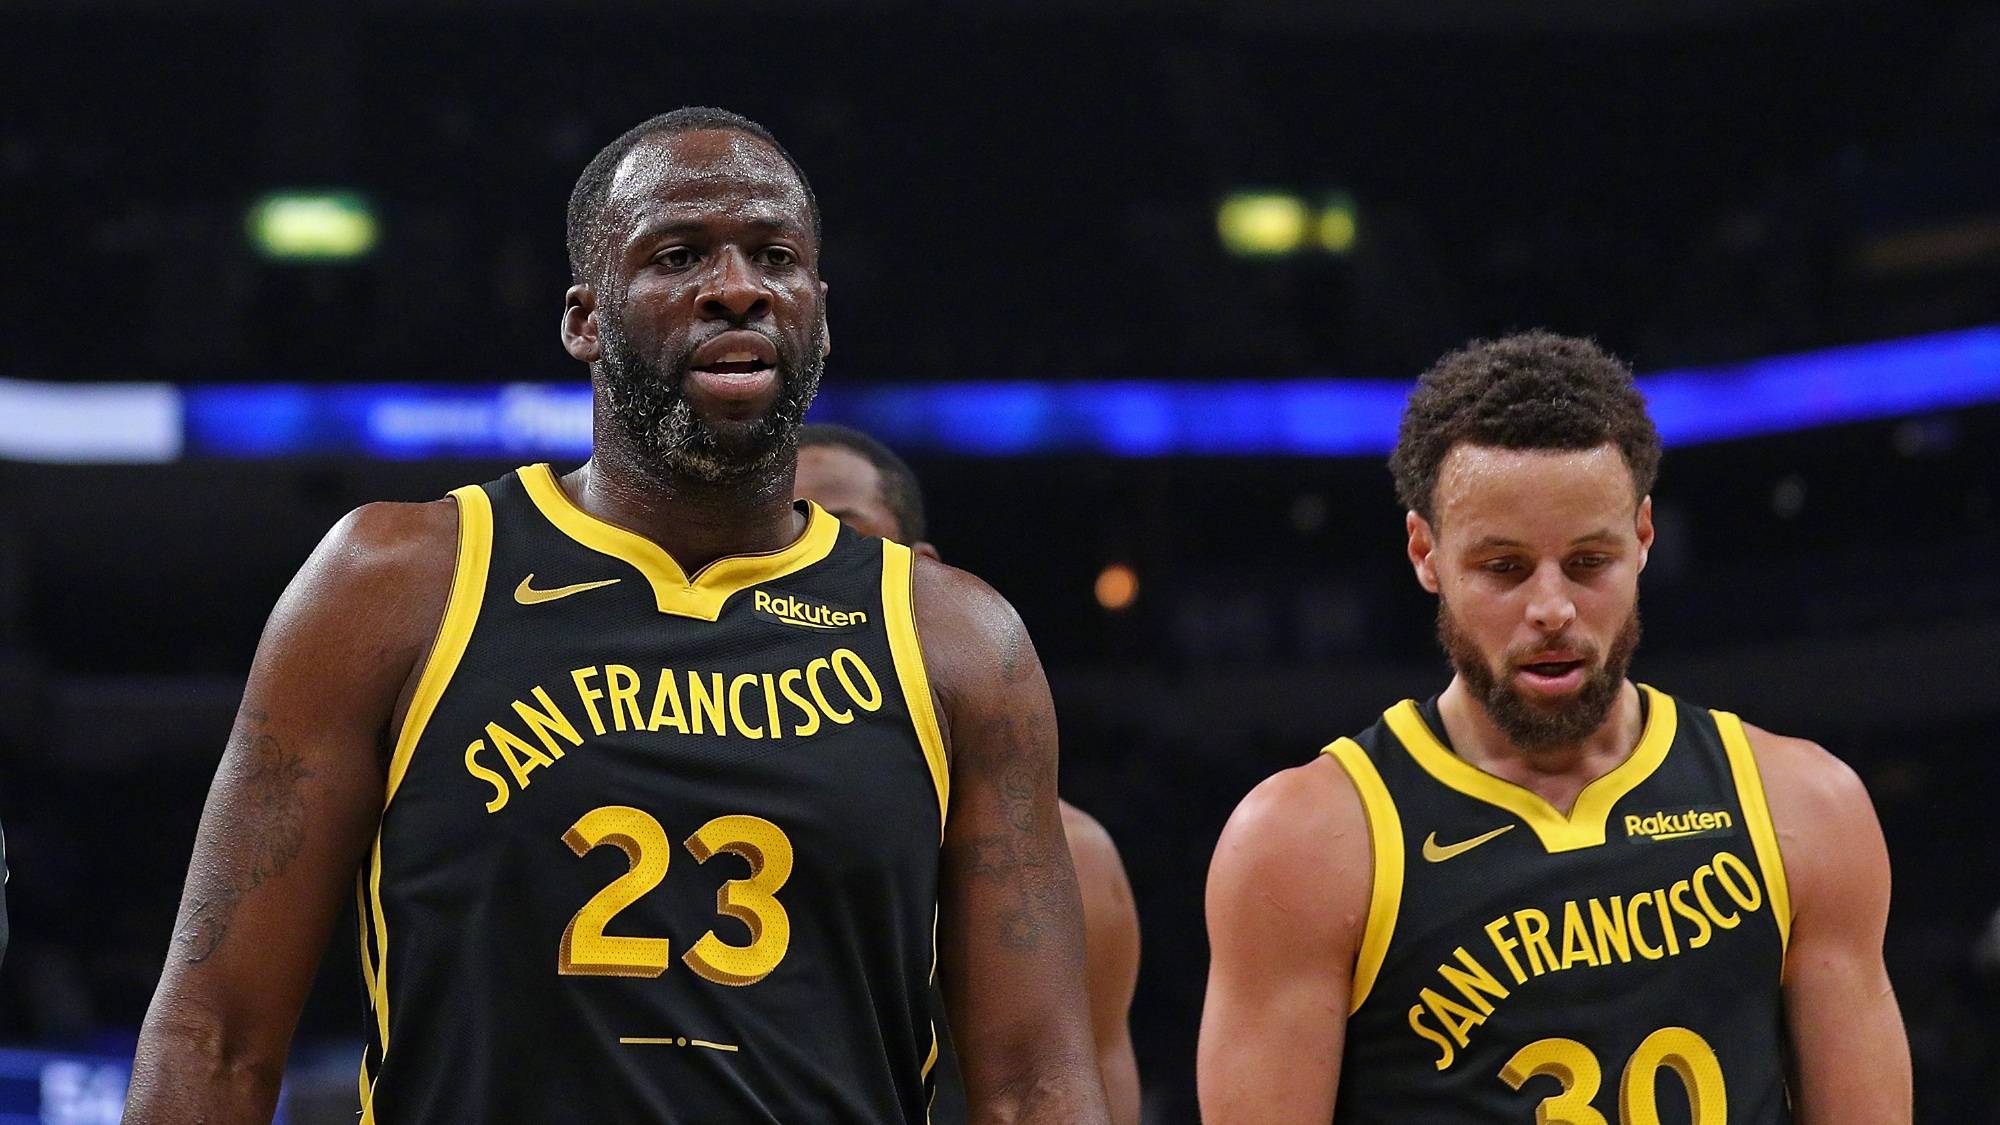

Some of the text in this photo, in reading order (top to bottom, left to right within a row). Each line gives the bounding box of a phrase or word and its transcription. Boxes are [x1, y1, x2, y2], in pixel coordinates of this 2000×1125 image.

[754, 589, 867, 628] Rakuten
[464, 648, 883, 814] SAN FRANCISCO
[1624, 808, 1733, 840] Rakuten
[558, 805, 794, 987] 23
[1408, 851, 1762, 1071] SAN FRANCISCO
[1498, 1026, 1728, 1125] 30
